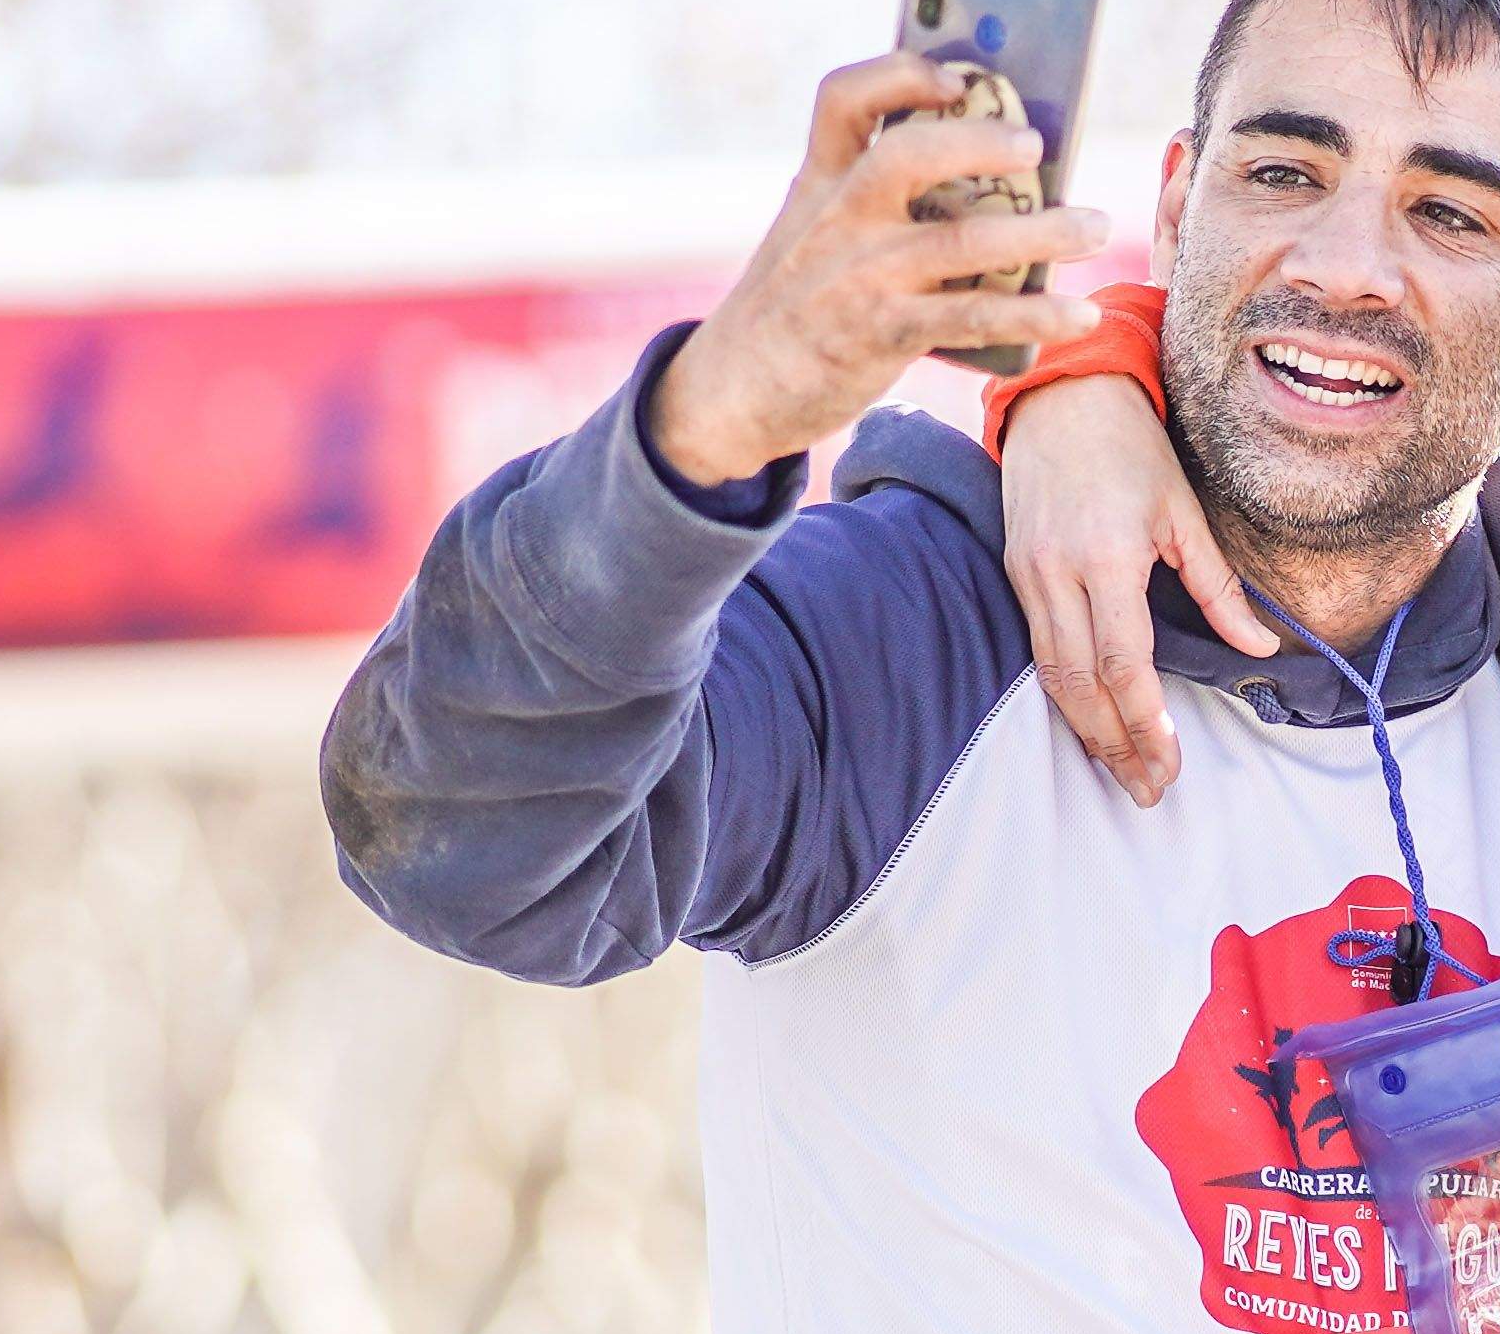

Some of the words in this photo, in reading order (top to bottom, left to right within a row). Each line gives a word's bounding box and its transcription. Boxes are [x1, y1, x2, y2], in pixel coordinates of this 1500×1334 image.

[1351, 968, 1392, 980] Comuni
[1351, 978, 1367, 989] de
[1259, 1165, 1372, 1196] CARRERA
[1355, 1204, 1373, 1220] de
[1223, 1203, 1364, 1293] REYES
[1223, 1286, 1382, 1334] COMUNIDAD
[1391, 1310, 1409, 1328] D
